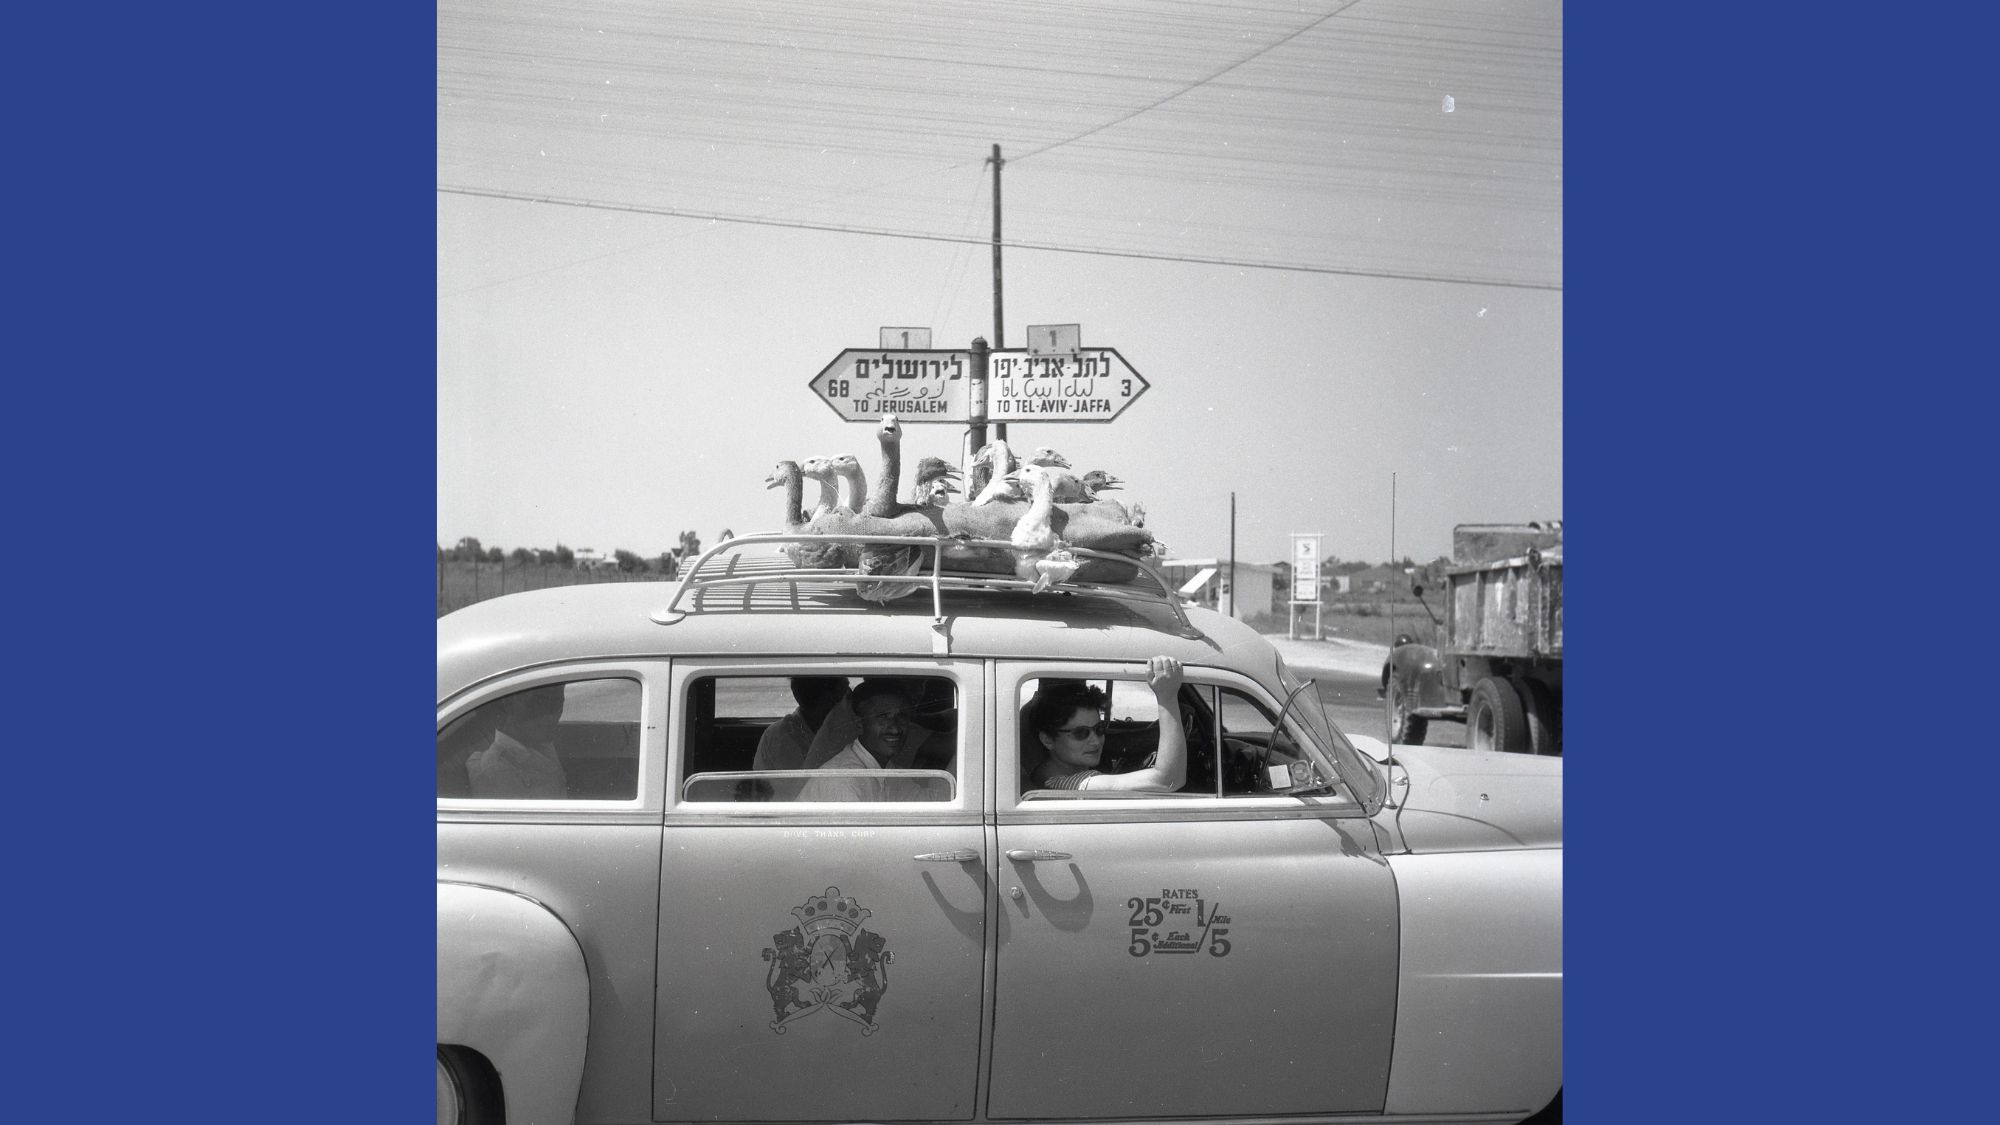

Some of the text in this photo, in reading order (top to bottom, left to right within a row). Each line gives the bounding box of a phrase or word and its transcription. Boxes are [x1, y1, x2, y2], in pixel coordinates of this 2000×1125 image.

[901, 331, 909, 349] 1
[1050, 330, 1057, 347] 1
[855, 353, 963, 380] לירושלים
[828, 379, 850, 398] 68
[1121, 379, 1132, 397] 3
[853, 400, 948, 413] TO JERUSALEM
[997, 400, 1112, 413] TO TEL-AVIV-JAFFA
[1162, 889, 1198, 899] RATES
